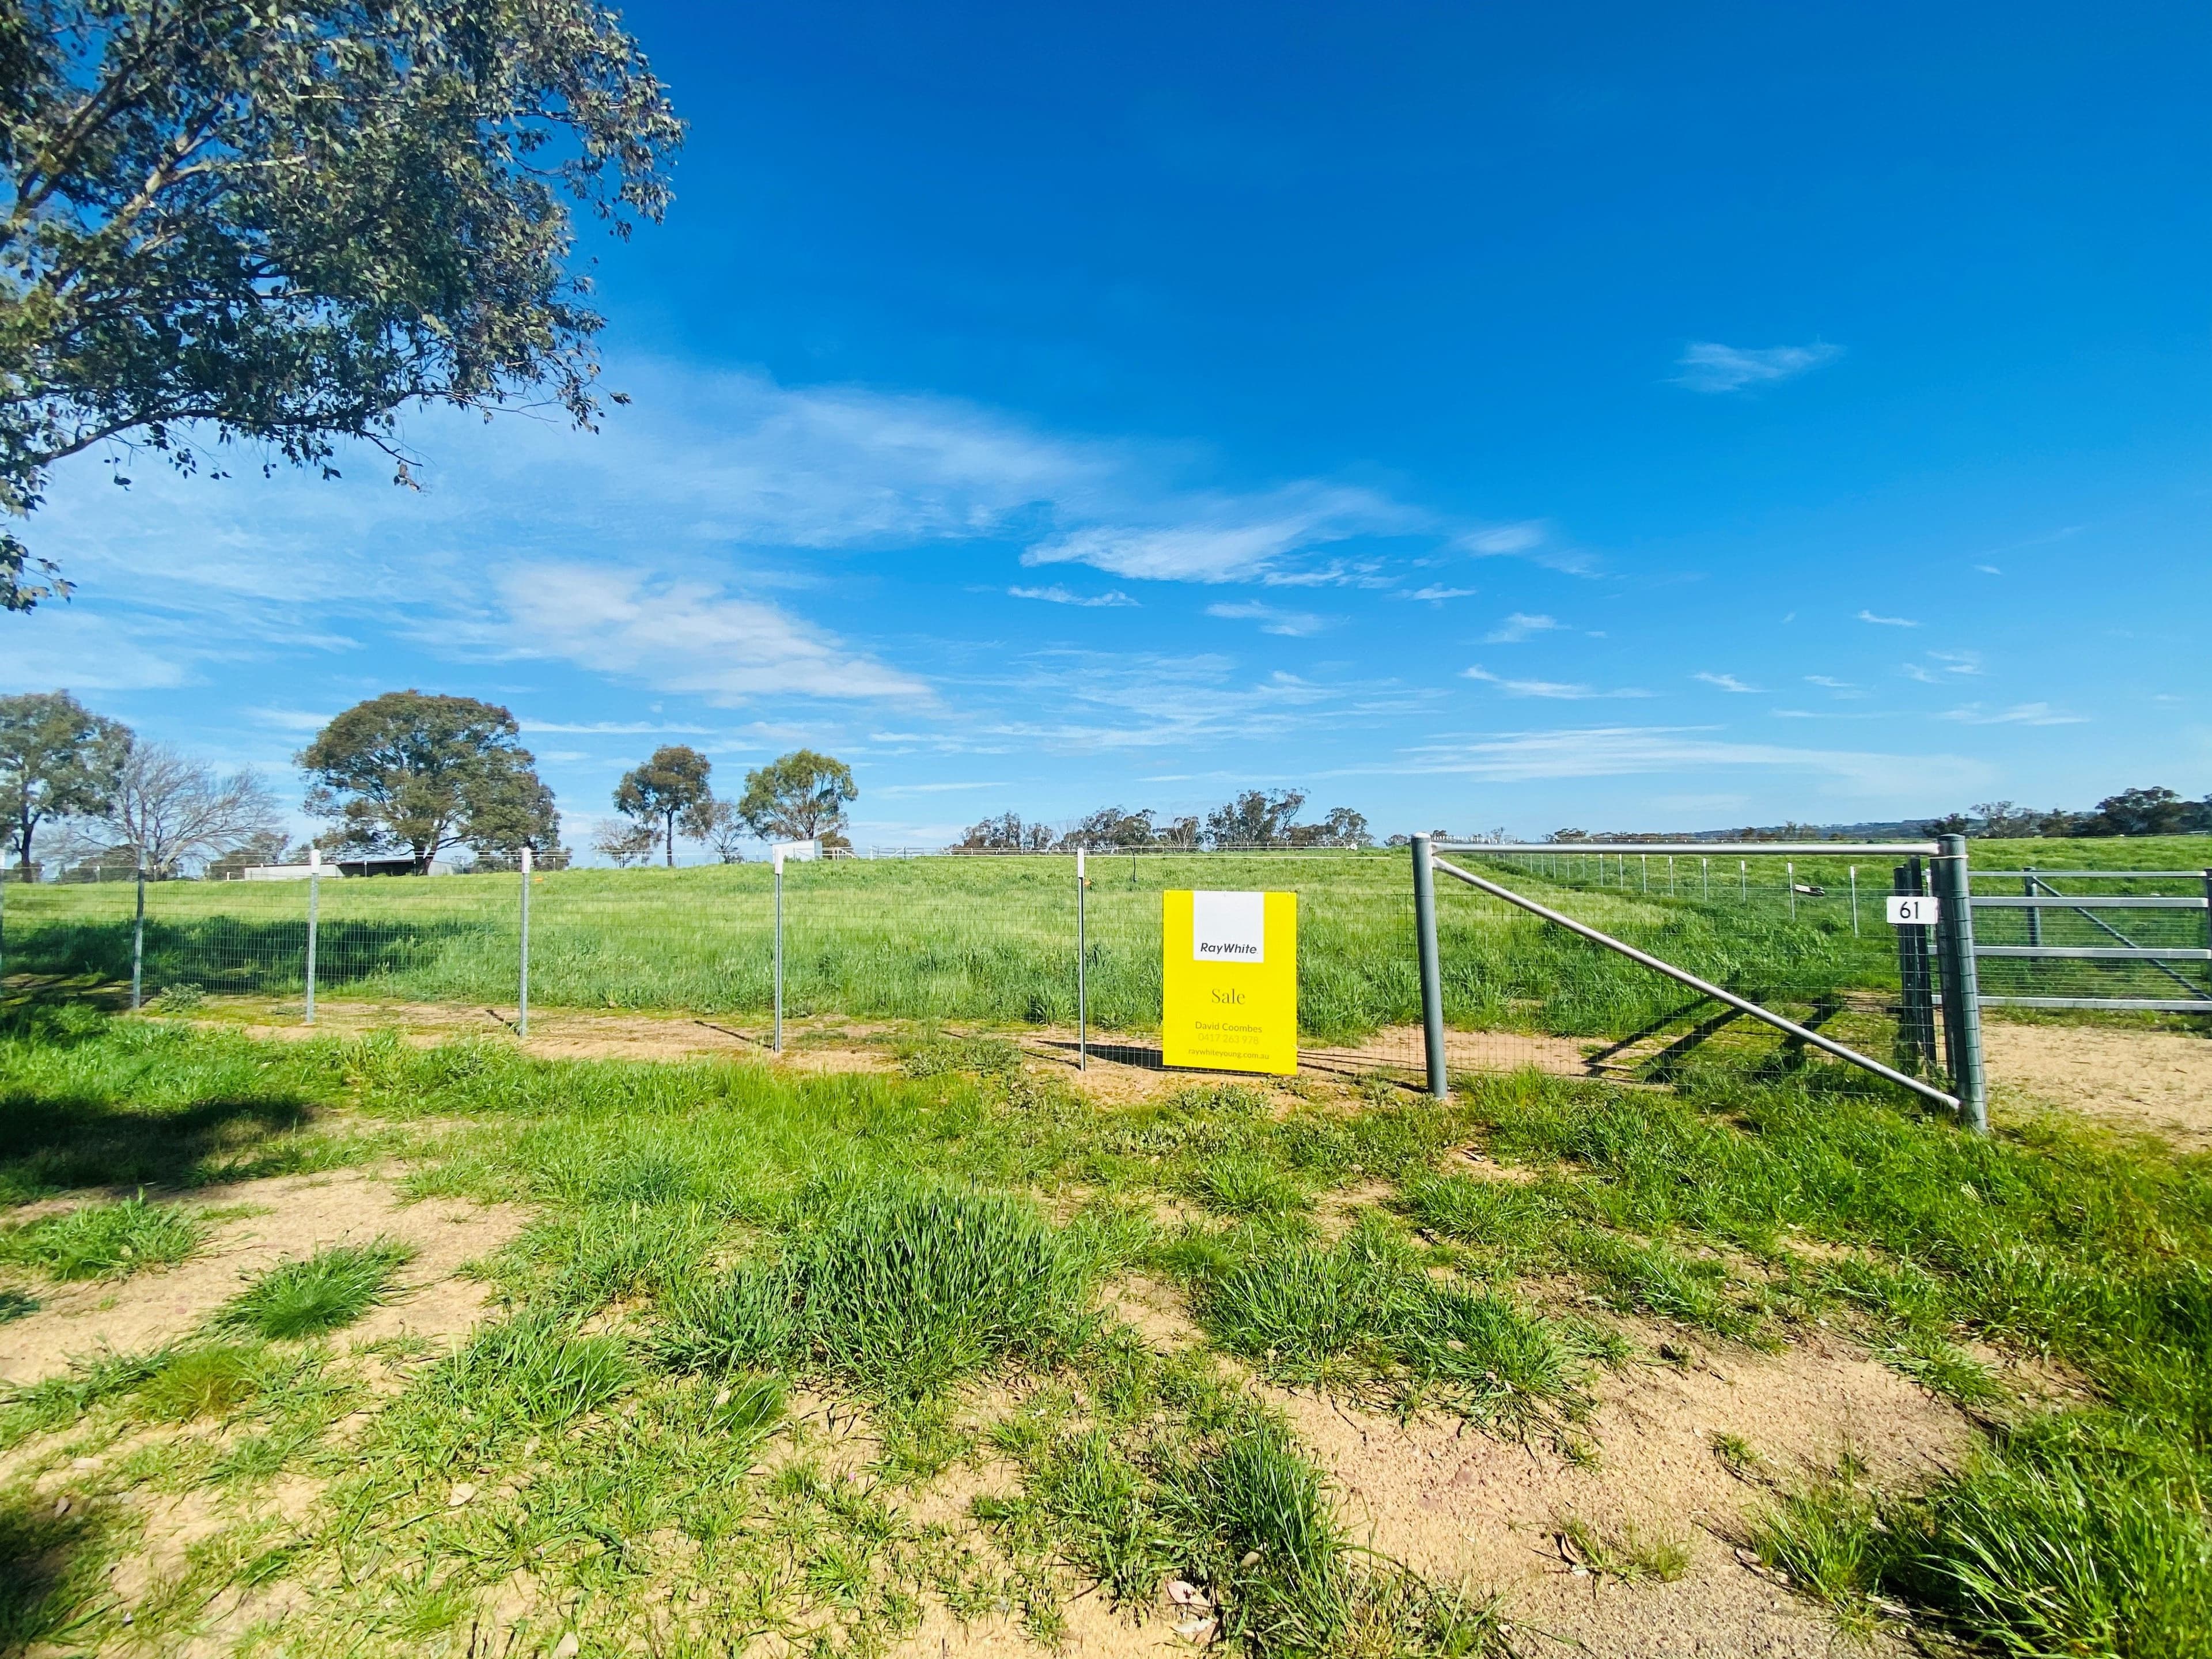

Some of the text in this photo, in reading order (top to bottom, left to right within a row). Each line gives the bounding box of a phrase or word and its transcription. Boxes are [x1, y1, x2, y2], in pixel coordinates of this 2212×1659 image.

[1900, 902, 1918, 919] 61
[1211, 988, 1245, 1005] Sale
[1195, 1021, 1263, 1033] David Coombes
[1198, 1033, 1259, 1045] 0417 263 978
[1188, 1048, 1270, 1060] raywhiteyoung.com.au
